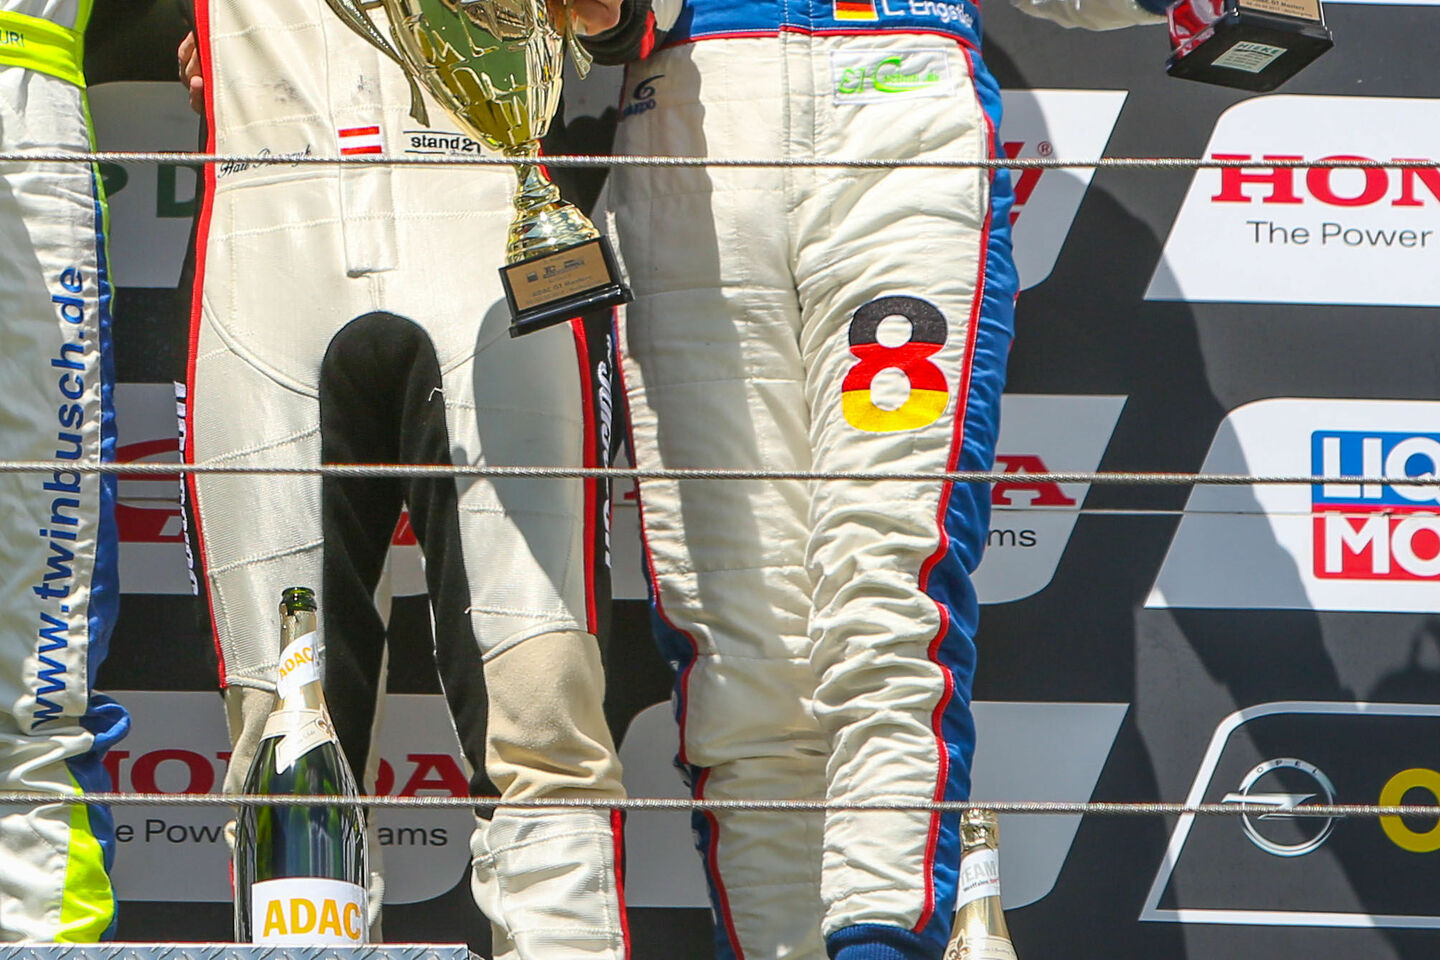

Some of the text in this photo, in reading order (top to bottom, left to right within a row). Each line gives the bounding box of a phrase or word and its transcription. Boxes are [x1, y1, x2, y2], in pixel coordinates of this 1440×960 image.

[1246, 220, 1433, 249] The Power
[841, 295, 949, 432] 8
[31, 265, 86, 730] www.twinbusch.de
[278, 647, 313, 681] ADAC
[145, 818, 222, 844] Pow
[960, 860, 997, 887] TEAM
[263, 897, 361, 940] ADAC
